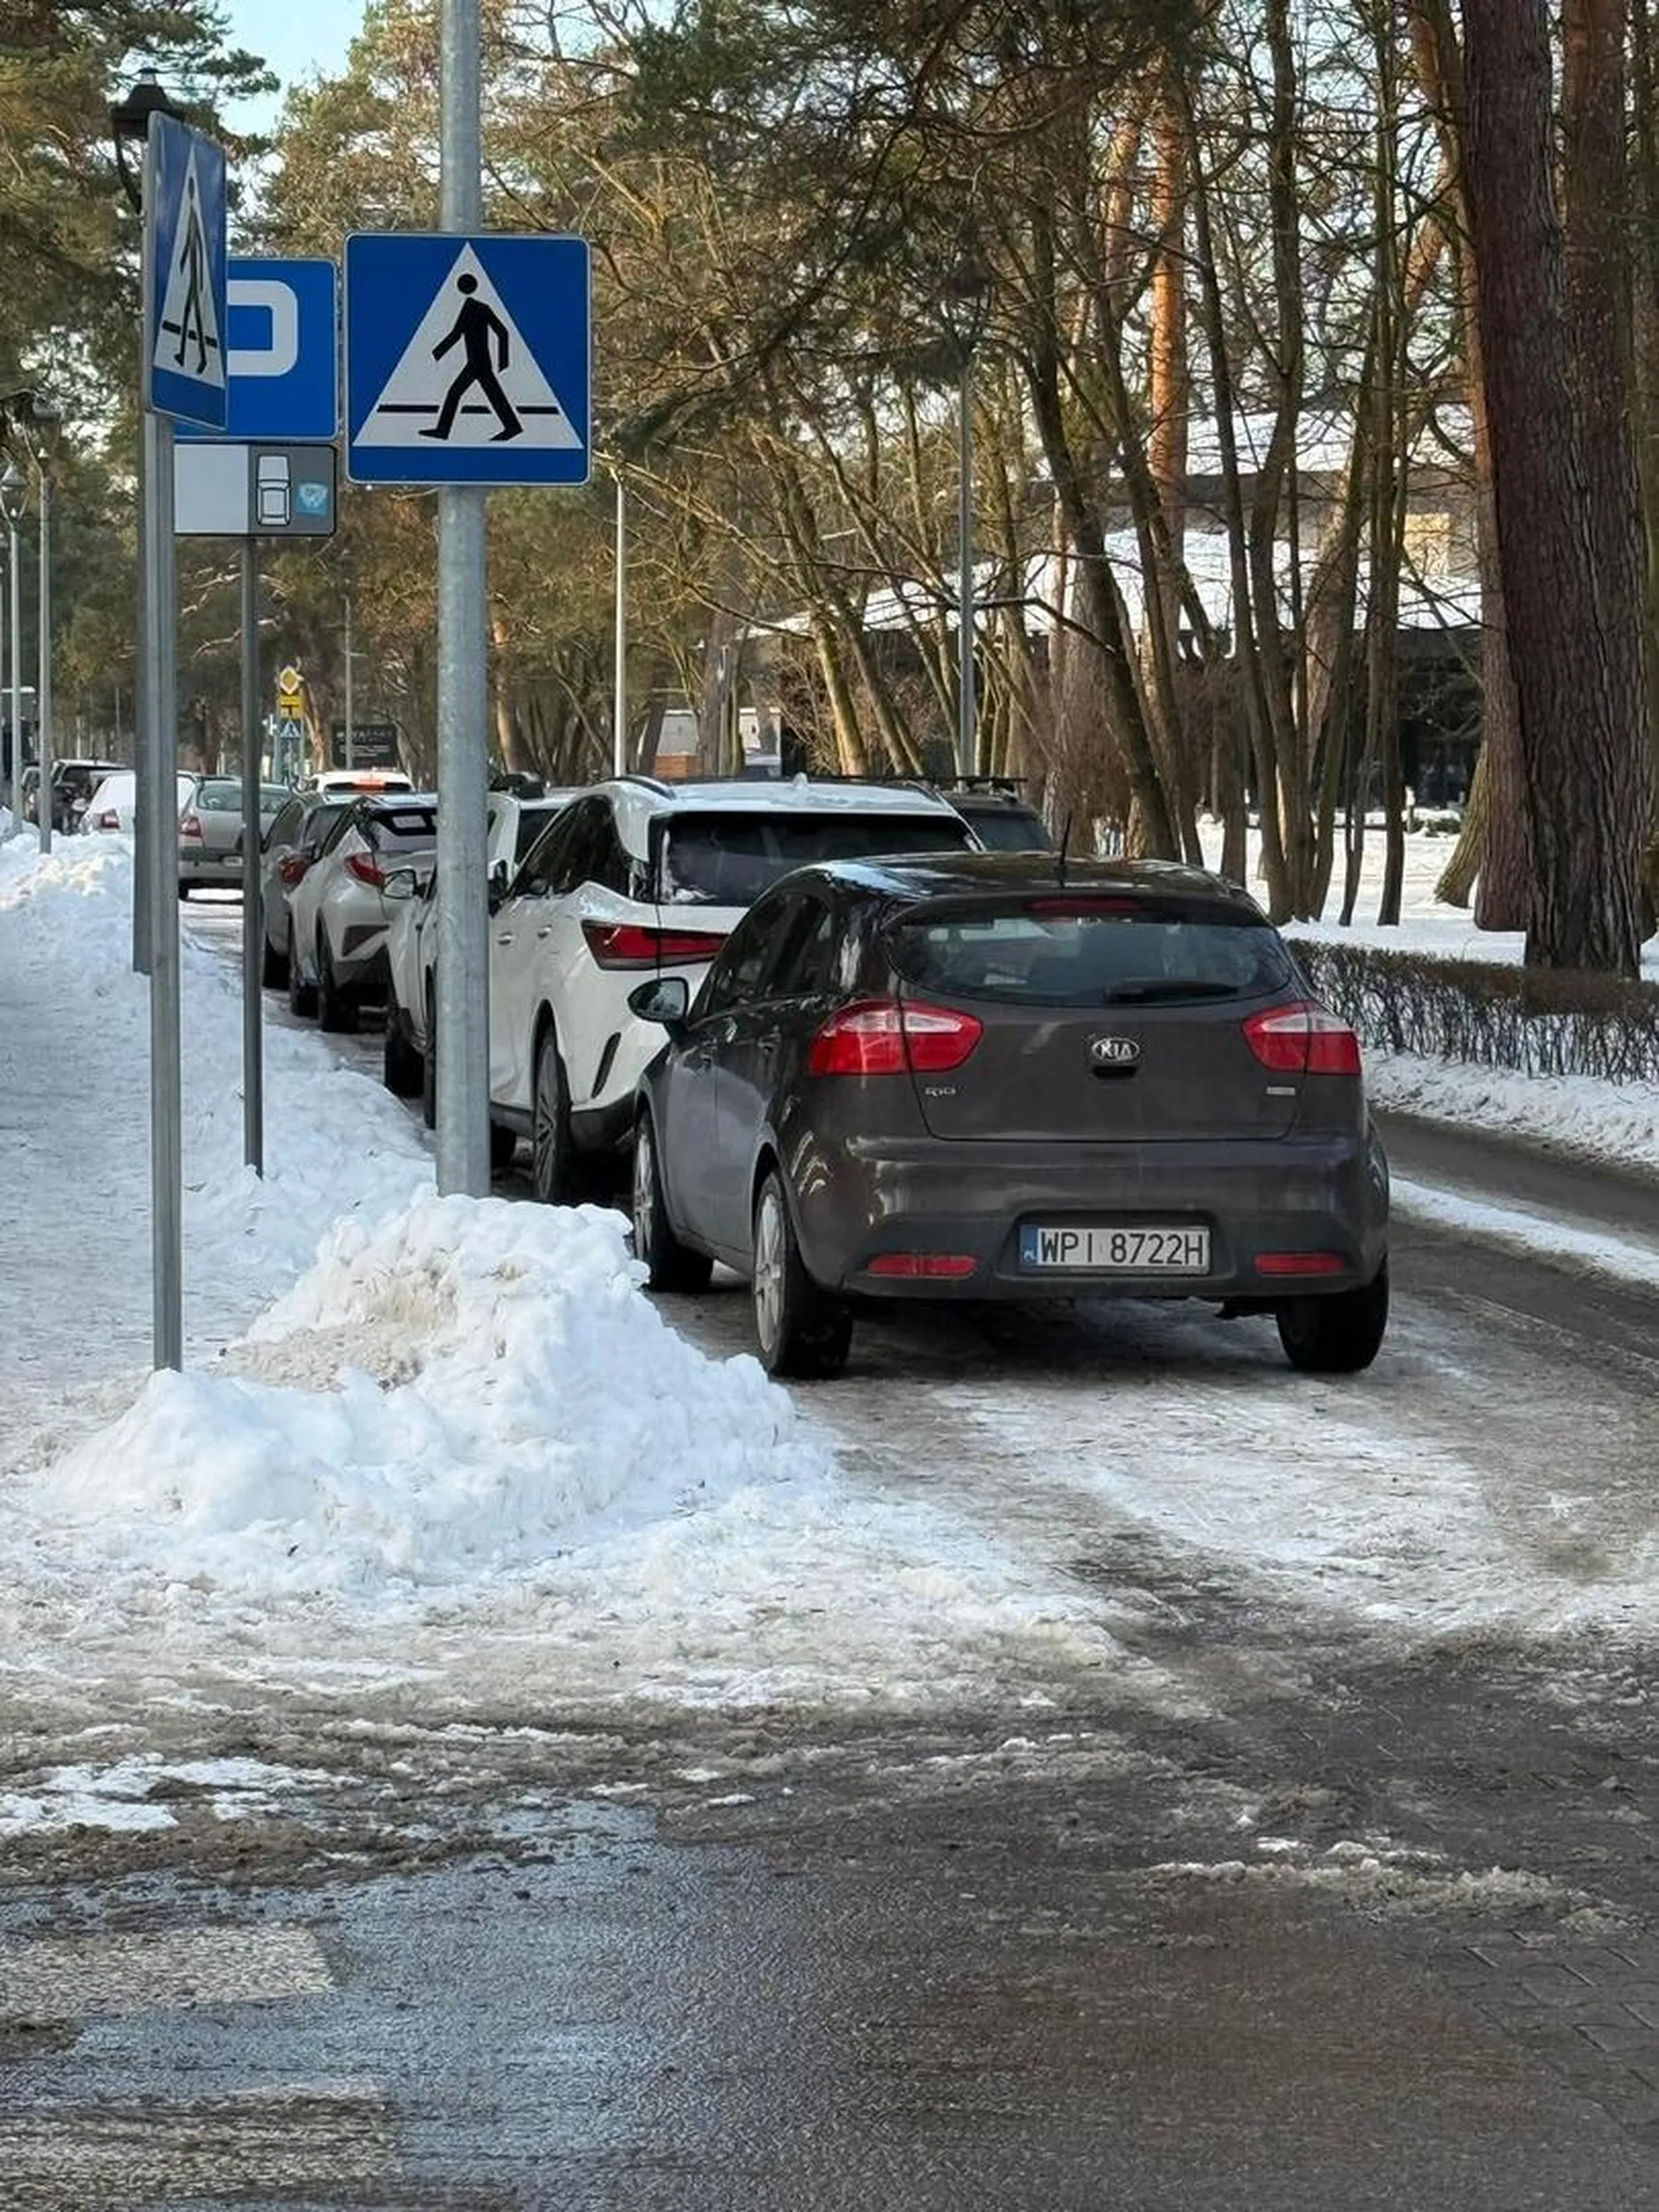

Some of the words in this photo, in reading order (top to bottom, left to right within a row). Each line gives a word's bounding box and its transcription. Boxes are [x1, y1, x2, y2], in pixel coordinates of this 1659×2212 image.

[1099, 1039, 1134, 1061] KIA
[1041, 1232, 1092, 1263] WPI
[1110, 1233, 1203, 1265] 8722H
